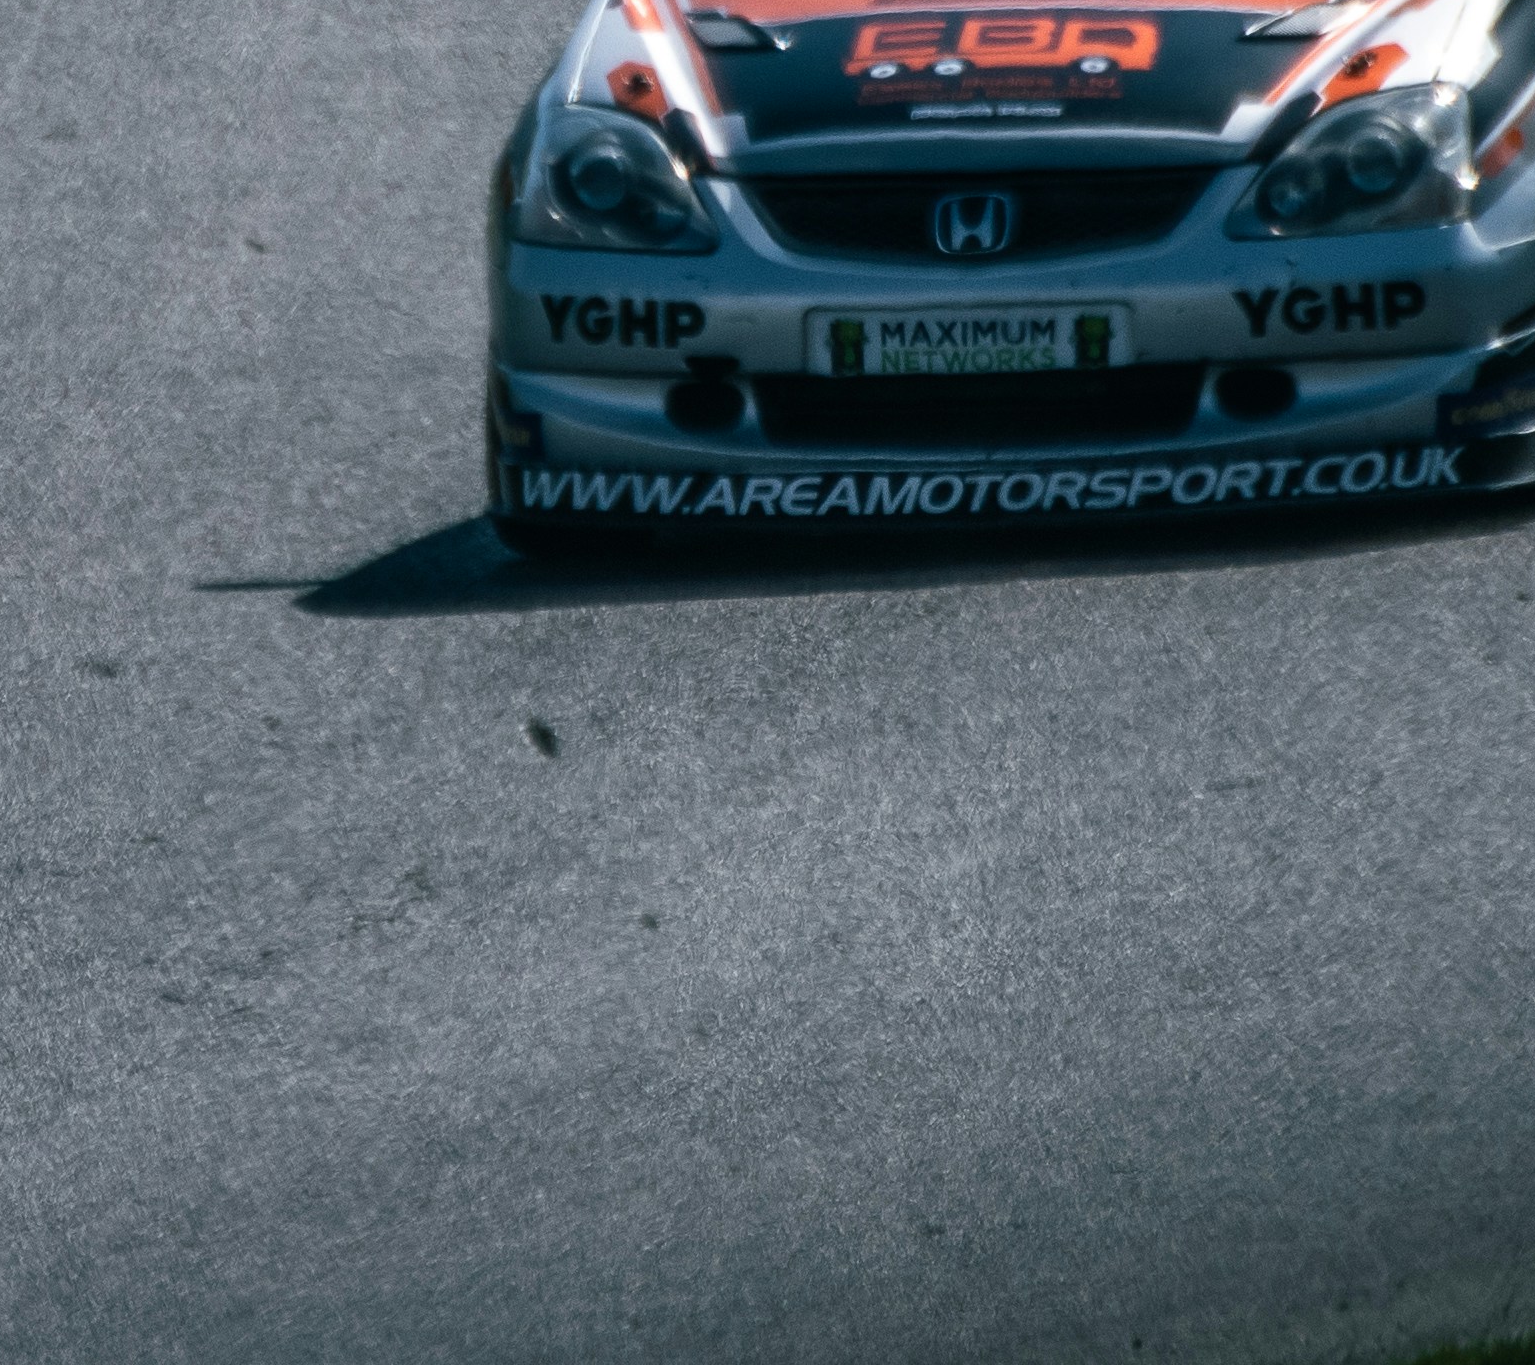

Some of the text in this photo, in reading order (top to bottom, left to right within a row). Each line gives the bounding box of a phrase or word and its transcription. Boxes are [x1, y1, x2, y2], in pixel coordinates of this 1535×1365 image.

[540, 294, 707, 348] YGHP
[881, 320, 1056, 346] MAXIMUM
[1232, 280, 1426, 337] YGHP
[881, 346, 1056, 372] NETWORKS
[521, 448, 1463, 517] WWW.AREAMOTORSPORT.CO.UK
